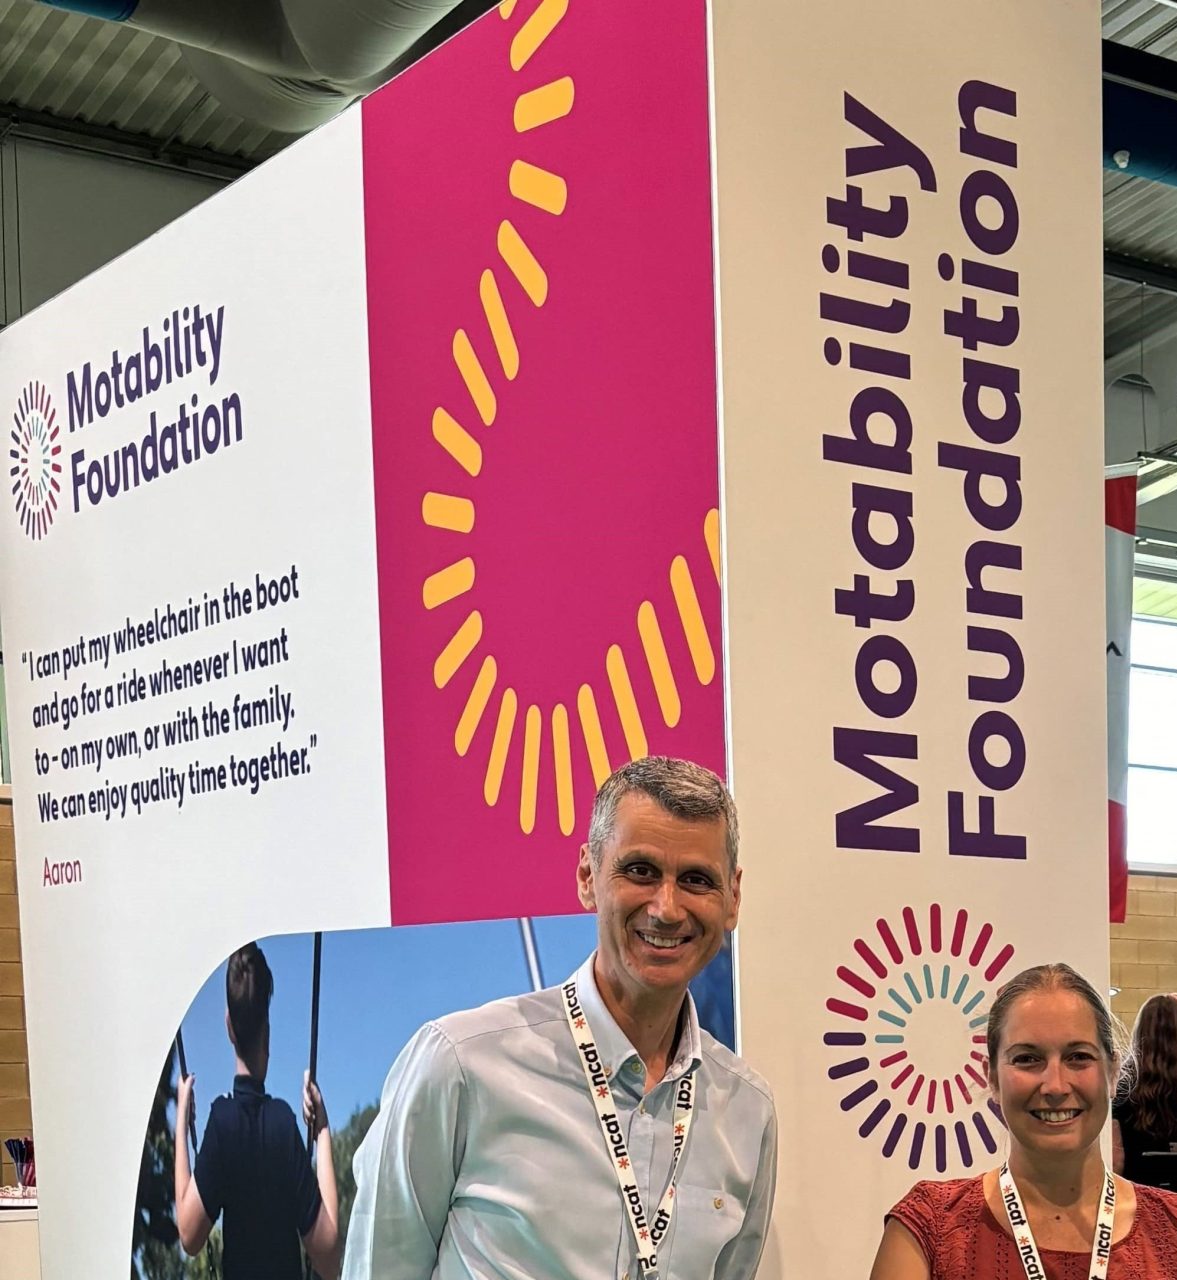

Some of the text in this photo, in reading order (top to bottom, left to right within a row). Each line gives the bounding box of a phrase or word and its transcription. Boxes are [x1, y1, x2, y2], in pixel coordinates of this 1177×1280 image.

[66, 304, 225, 433] Motability
[71, 392, 243, 513] Foundation
[820, 90, 937, 853] Motability
[937, 78, 1027, 860] Foundation
[36, 651, 60, 678] can
[62, 636, 86, 680] put
[89, 634, 111, 669] my
[114, 598, 200, 654] wheelchair
[204, 593, 220, 627] in
[223, 582, 252, 620] the
[256, 565, 299, 610] boot
[33, 627, 289, 730] and go for a ride whenever I want
[35, 748, 49, 776] to
[61, 745, 79, 770] on
[81, 739, 102, 773] my
[106, 731, 142, 759] own,
[144, 725, 160, 750] or
[163, 706, 199, 747] with
[202, 701, 230, 737] the
[233, 684, 295, 732] family.
[38, 792, 58, 823] We
[62, 793, 85, 819] can
[88, 780, 127, 821] enjoy
[131, 767, 185, 815] quality
[189, 760, 226, 795] time
[43, 857, 82, 887] Aaron
[563, 982, 582, 1019] ncat
[579, 1043, 606, 1086] ncat
[601, 1113, 627, 1158] ncat
[623, 1184, 646, 1229] ncat
[1005, 1192, 1027, 1226] ncat
[638, 1254, 657, 1269] nc
[1021, 1244, 1044, 1280] ncat
[1096, 1222, 1112, 1258] ncat
